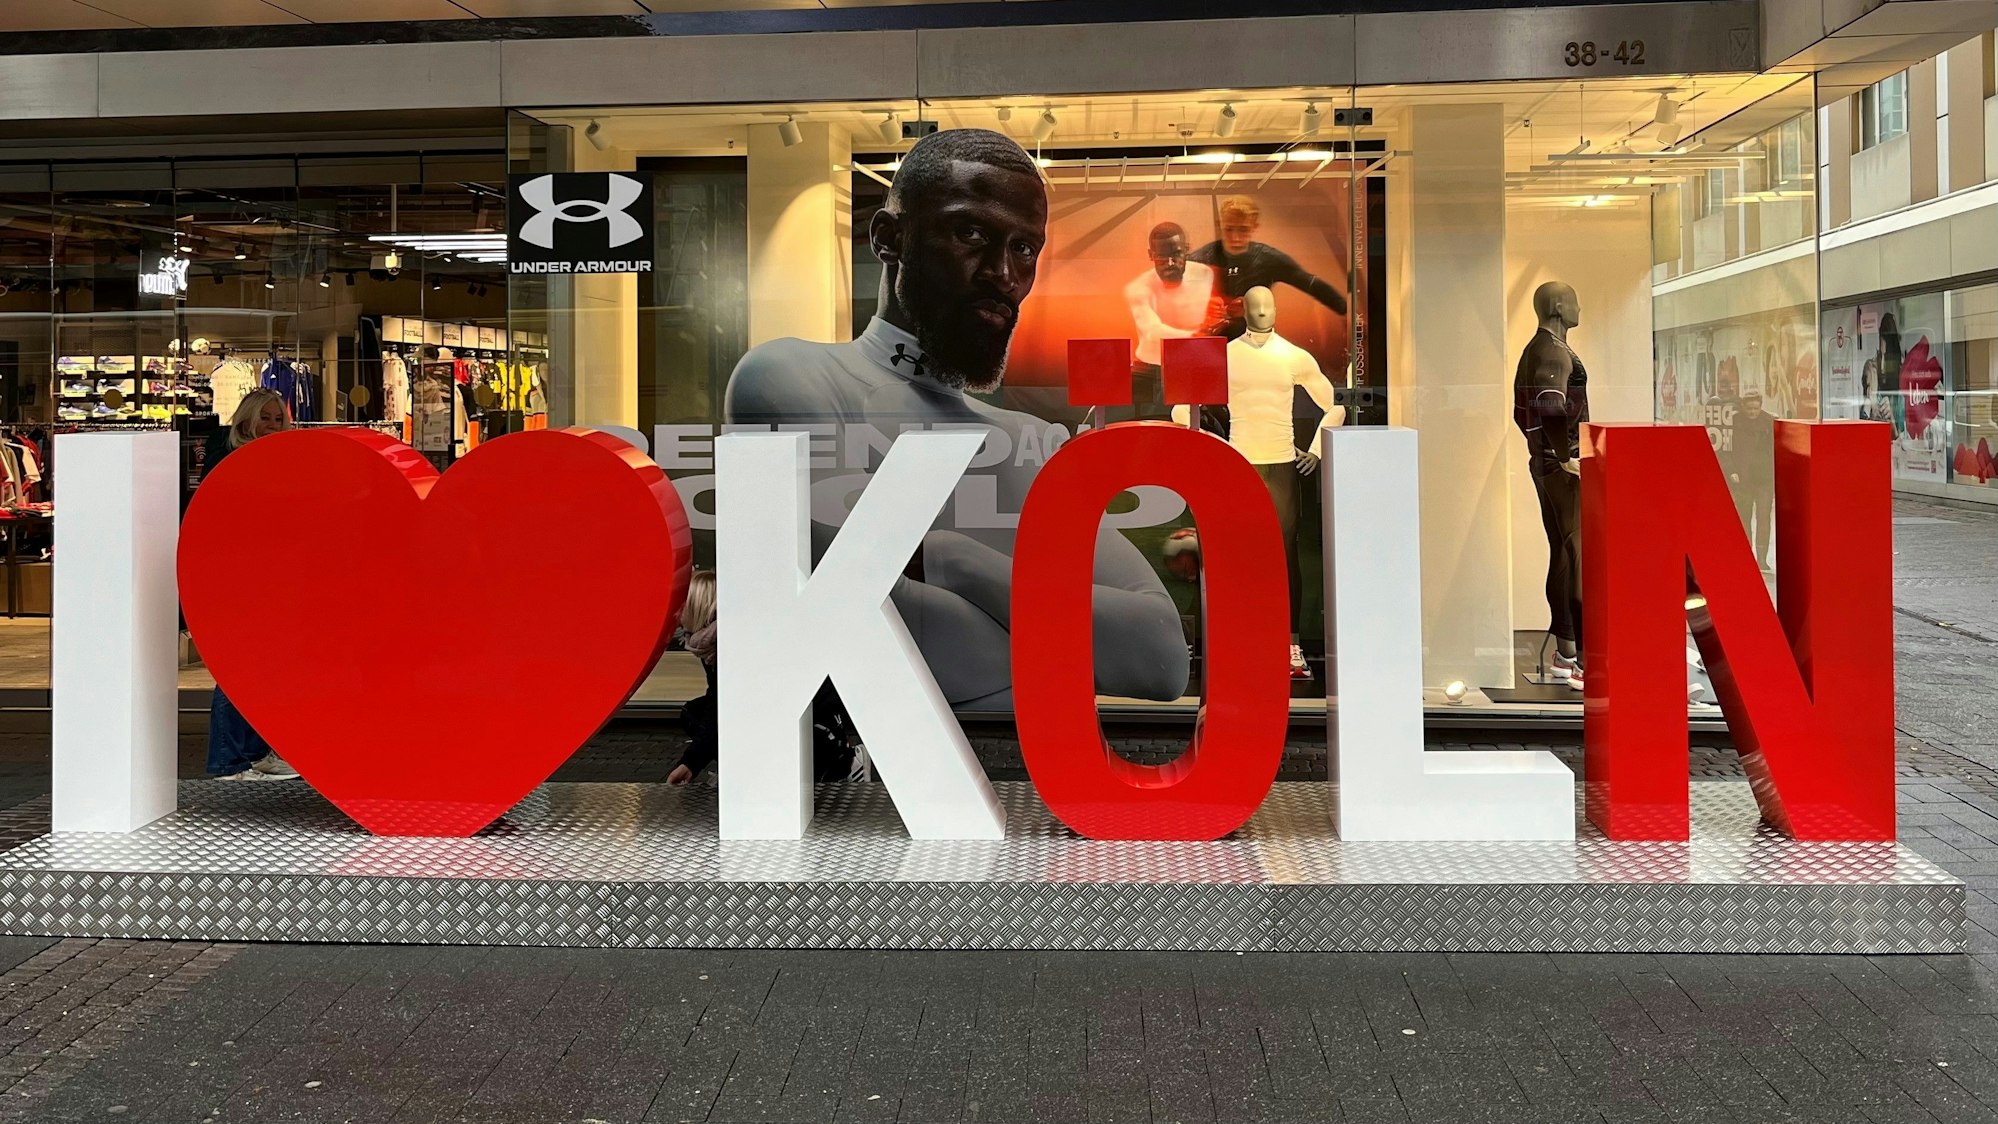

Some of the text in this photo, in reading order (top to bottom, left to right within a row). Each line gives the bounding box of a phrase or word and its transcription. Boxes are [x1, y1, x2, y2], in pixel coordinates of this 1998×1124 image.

[1564, 40, 1646, 67] 38-42
[510, 260, 652, 273] UNDER ARMOUR
[52, 337, 1896, 843] I KÖLN
